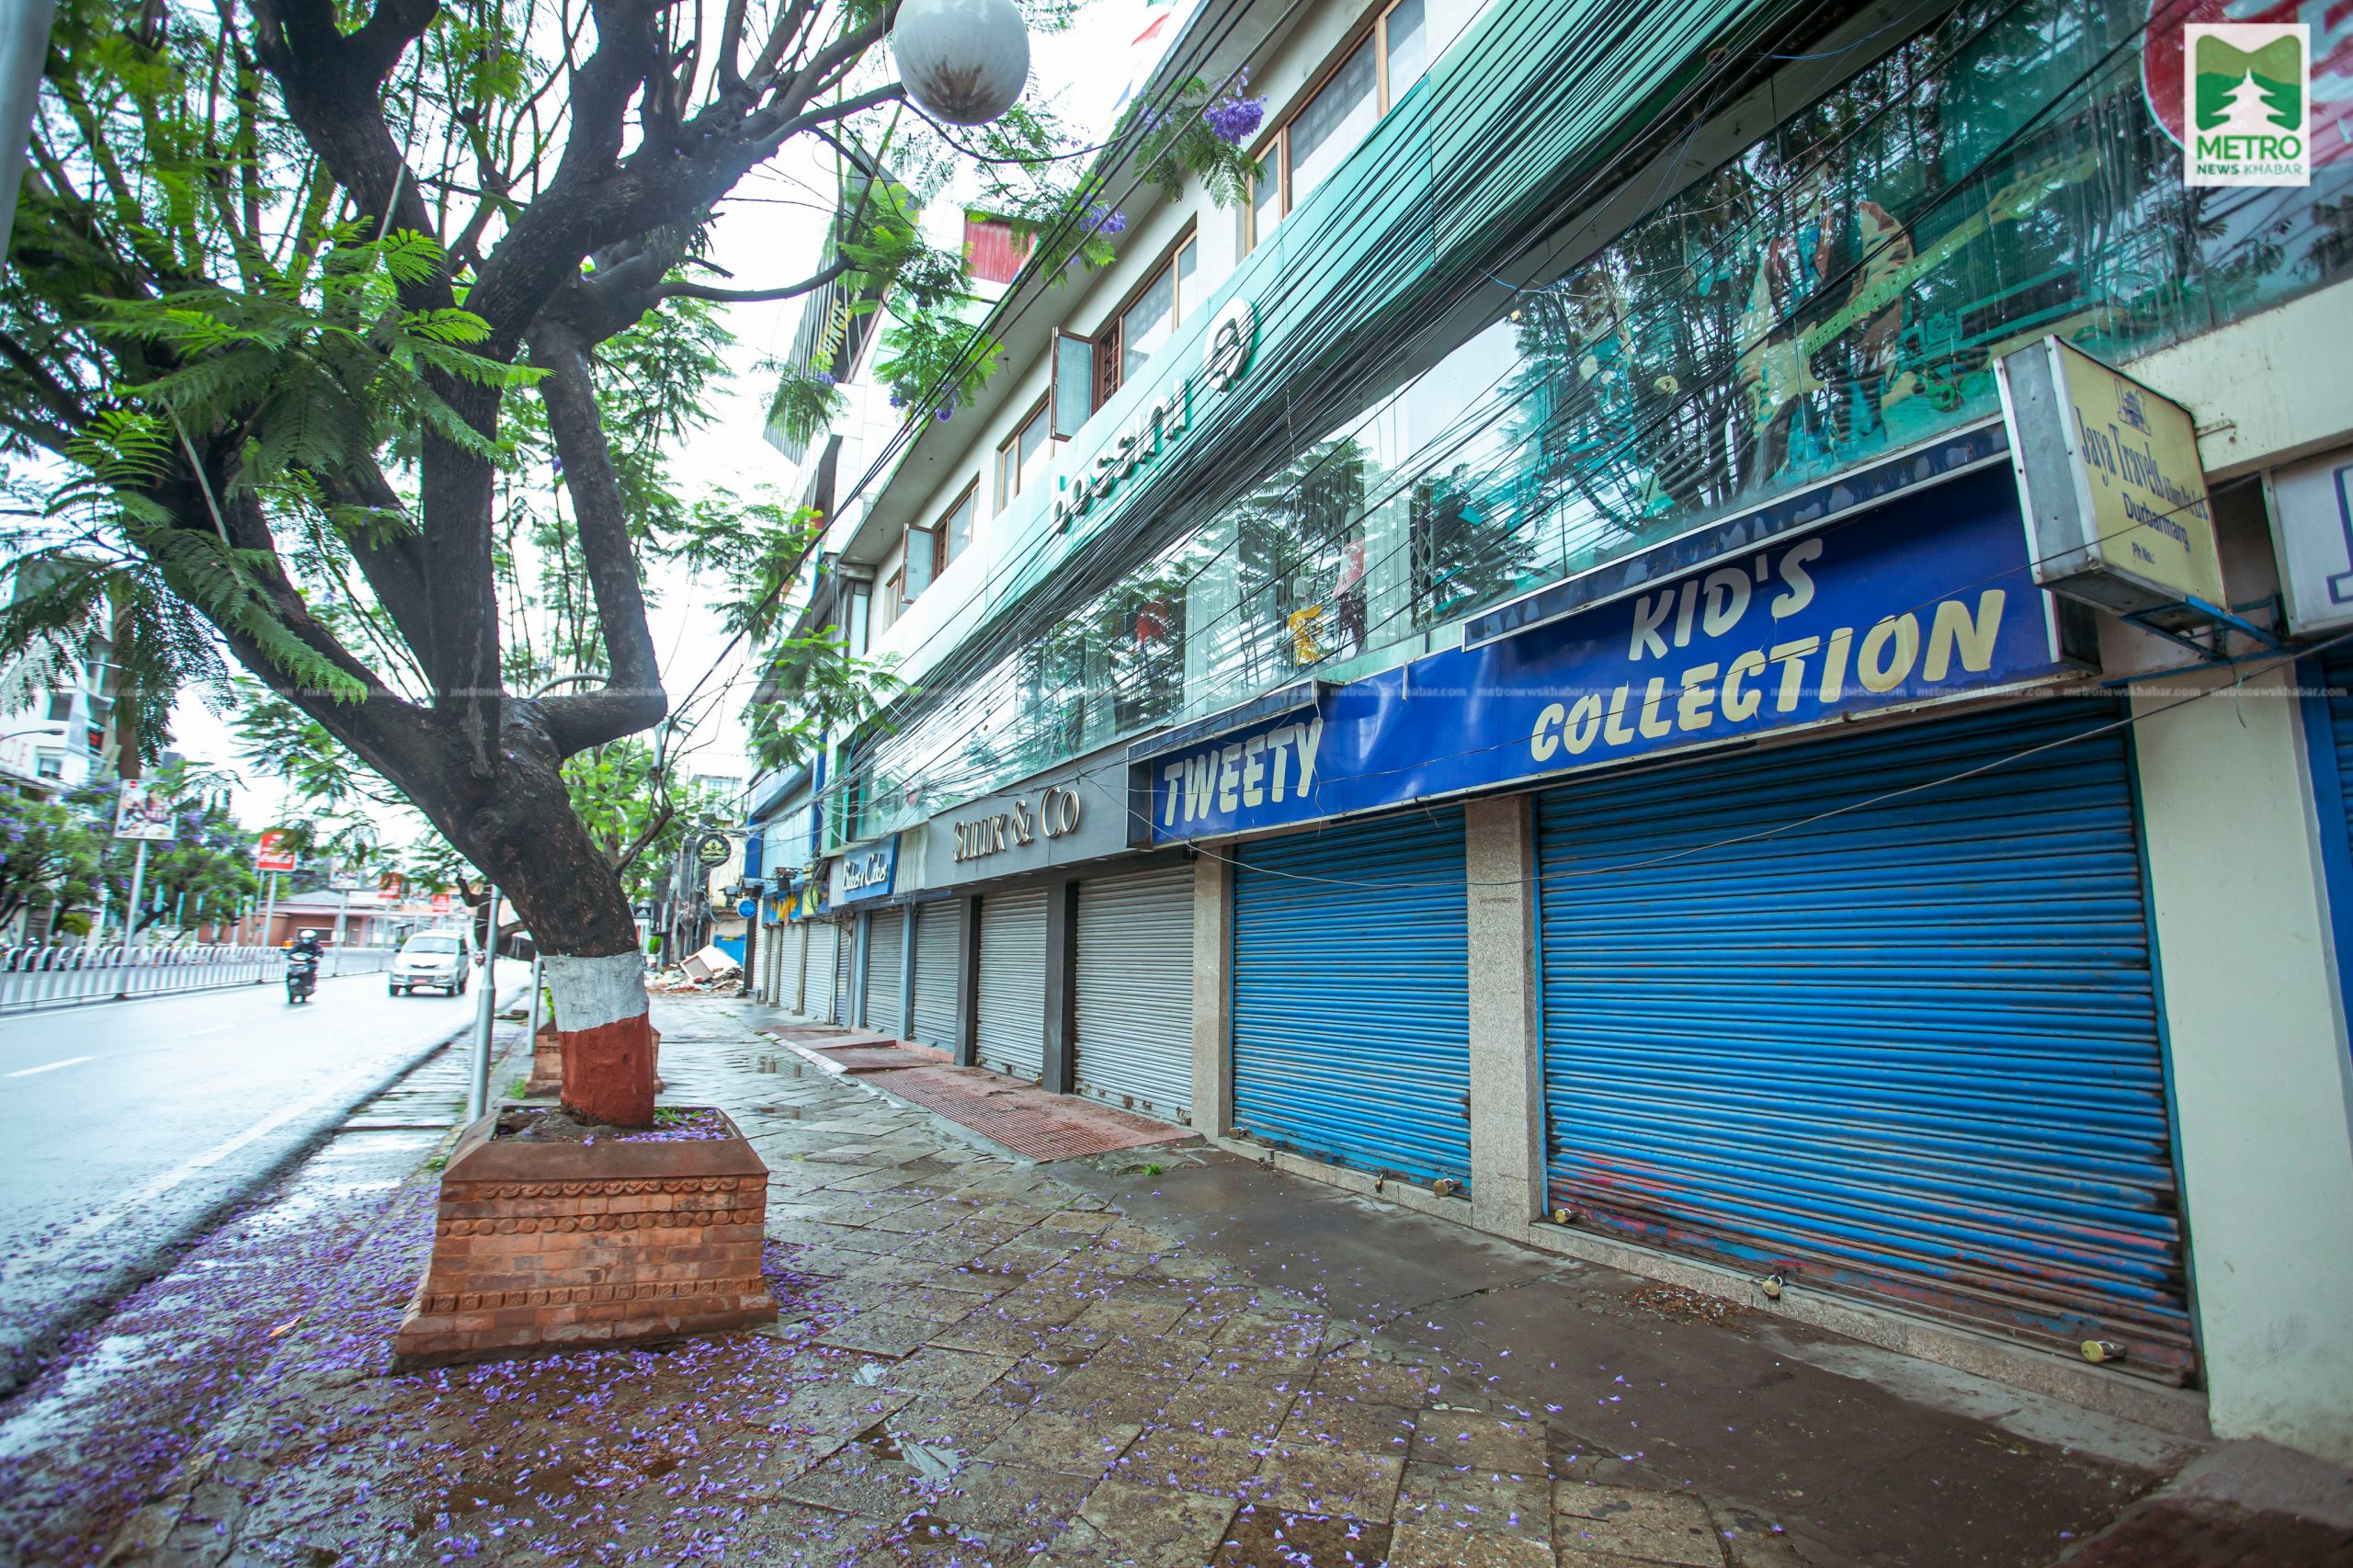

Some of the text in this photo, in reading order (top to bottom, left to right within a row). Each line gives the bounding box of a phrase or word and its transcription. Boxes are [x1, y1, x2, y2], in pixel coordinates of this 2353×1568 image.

[2075, 406, 2117, 487] Jaya
[2108, 423, 2165, 499] Travels
[2122, 492, 2190, 553] Durbarmarg
[1628, 538, 1823, 661] KID'S
[1164, 589, 2006, 826] TWEETY COLLECTION
[1011, 799, 1034, 845] &
